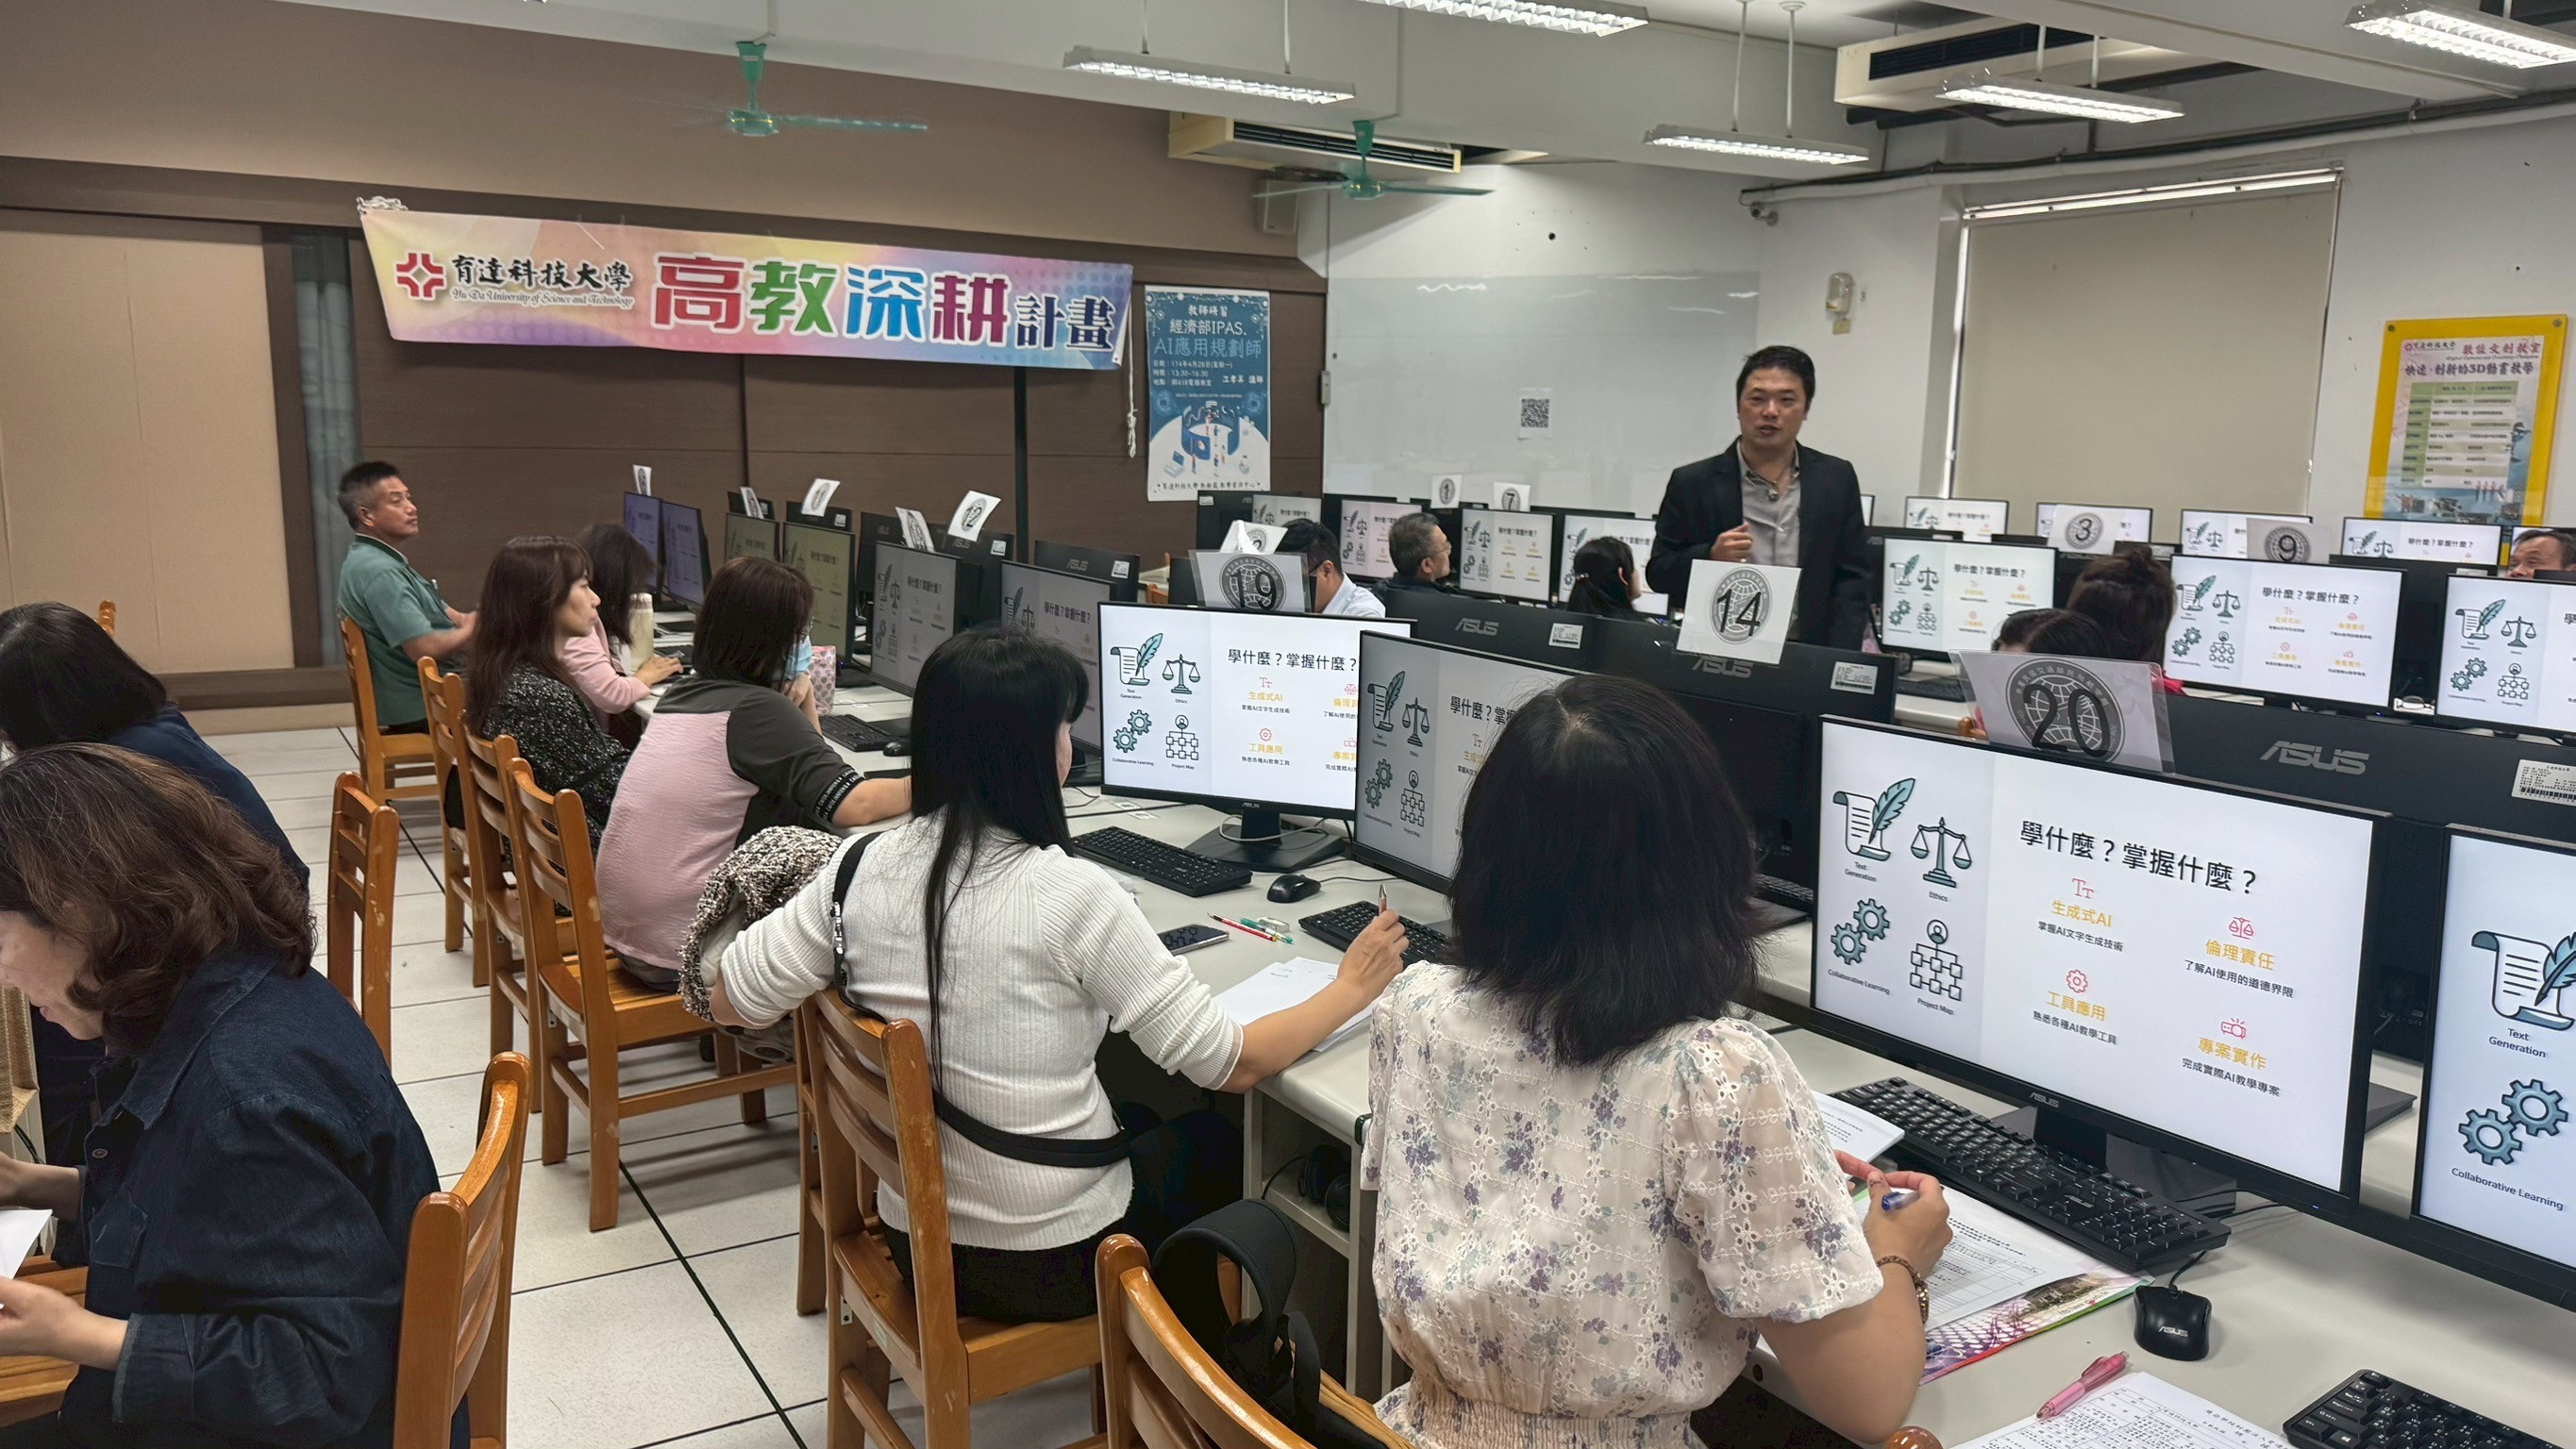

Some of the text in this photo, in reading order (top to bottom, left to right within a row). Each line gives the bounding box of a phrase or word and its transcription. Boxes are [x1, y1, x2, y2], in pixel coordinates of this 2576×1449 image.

[452, 255, 631, 291] 育達科技大學
[487, 290, 529, 305] University
[531, 291, 541, 305] of
[541, 292, 571, 304] Science
[572, 294, 586, 304] and
[588, 294, 633, 307] Technology
[653, 253, 1116, 351] 高教深耕計畫
[1154, 338, 1262, 358] AI應用規劃師
[2076, 518, 2093, 541] 3
[2280, 534, 2298, 562] 9
[1229, 570, 1277, 610] 19
[1717, 589, 1761, 637] 14
[1455, 618, 1499, 637] ASUS
[1248, 691, 1283, 702] 生成式AI
[2023, 684, 2110, 758] 20
[2260, 740, 2370, 776] ASUS
[1854, 861, 1867, 871] Text
[2020, 820, 2257, 894] 學什麼？掌握什麼？
[1844, 868, 1877, 882] Generation
[1929, 891, 1949, 902] Ethics
[2051, 899, 2113, 927] 生成式AI
[2037, 921, 2124, 952] 掌握AI文字生成技術
[2205, 939, 2276, 971] 倫理責任
[1828, 968, 1890, 995] Collaborative Learning
[2184, 958, 2294, 998] 了解AI使用的道德界限
[1917, 997, 1954, 1015] Project Map
[2046, 991, 2106, 1022] 工具應用
[2032, 1010, 2117, 1045] 熟悉各種AI教學工具
[2507, 1027, 2530, 1041] Text
[2198, 1037, 2267, 1071] 專案實作
[2488, 1036, 2547, 1058] Generation
[2182, 1057, 2280, 1097] 完成實際AI教學專案
[2029, 1091, 2060, 1108] ASUS
[2451, 1167, 2564, 1211] Collaborative Learning
[2158, 1325, 2189, 1338] ASUS
